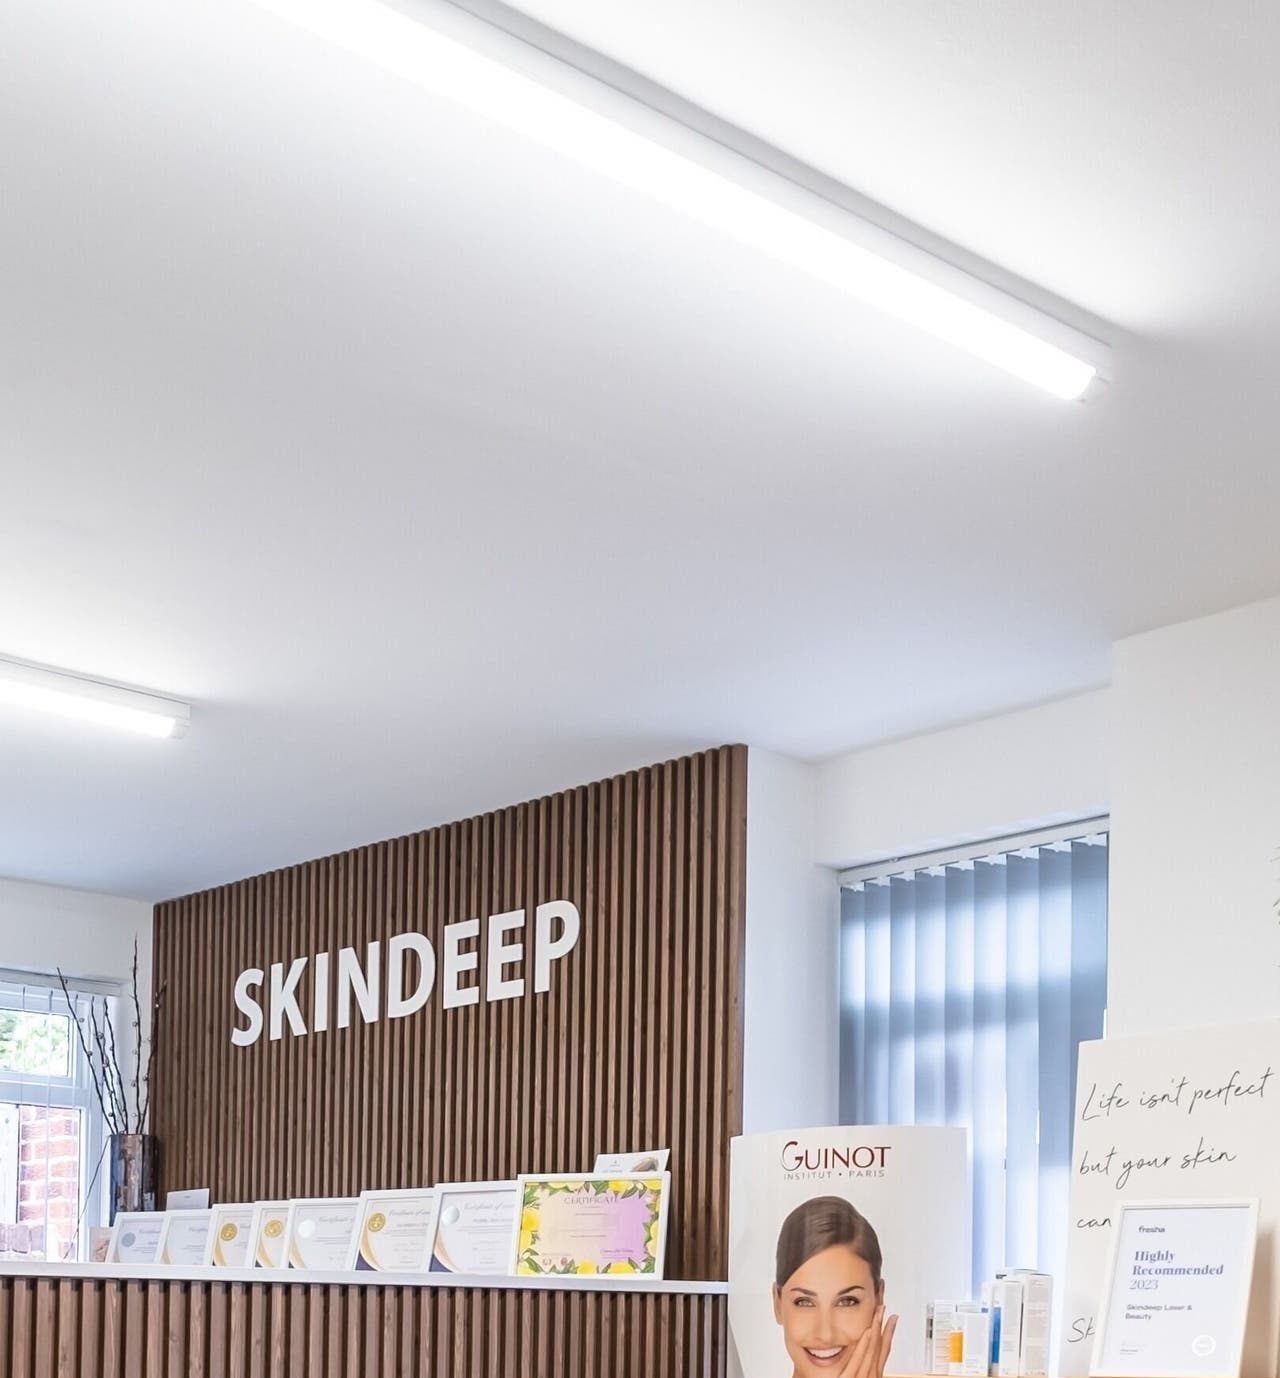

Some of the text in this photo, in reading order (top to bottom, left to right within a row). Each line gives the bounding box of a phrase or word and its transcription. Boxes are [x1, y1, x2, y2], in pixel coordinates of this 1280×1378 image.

[230, 900, 581, 1047] SKINDEEP
[1082, 1067, 1275, 1121] Life isn't perfect
[780, 1140, 891, 1171] GUINOT
[1080, 1136, 1238, 1190] but your skin
[784, 1170, 885, 1181] INSTITUT PARIS
[1134, 1250, 1175, 1264] Highly
[1132, 1264, 1224, 1276] Recommended
[1129, 1280, 1159, 1290] 2023
